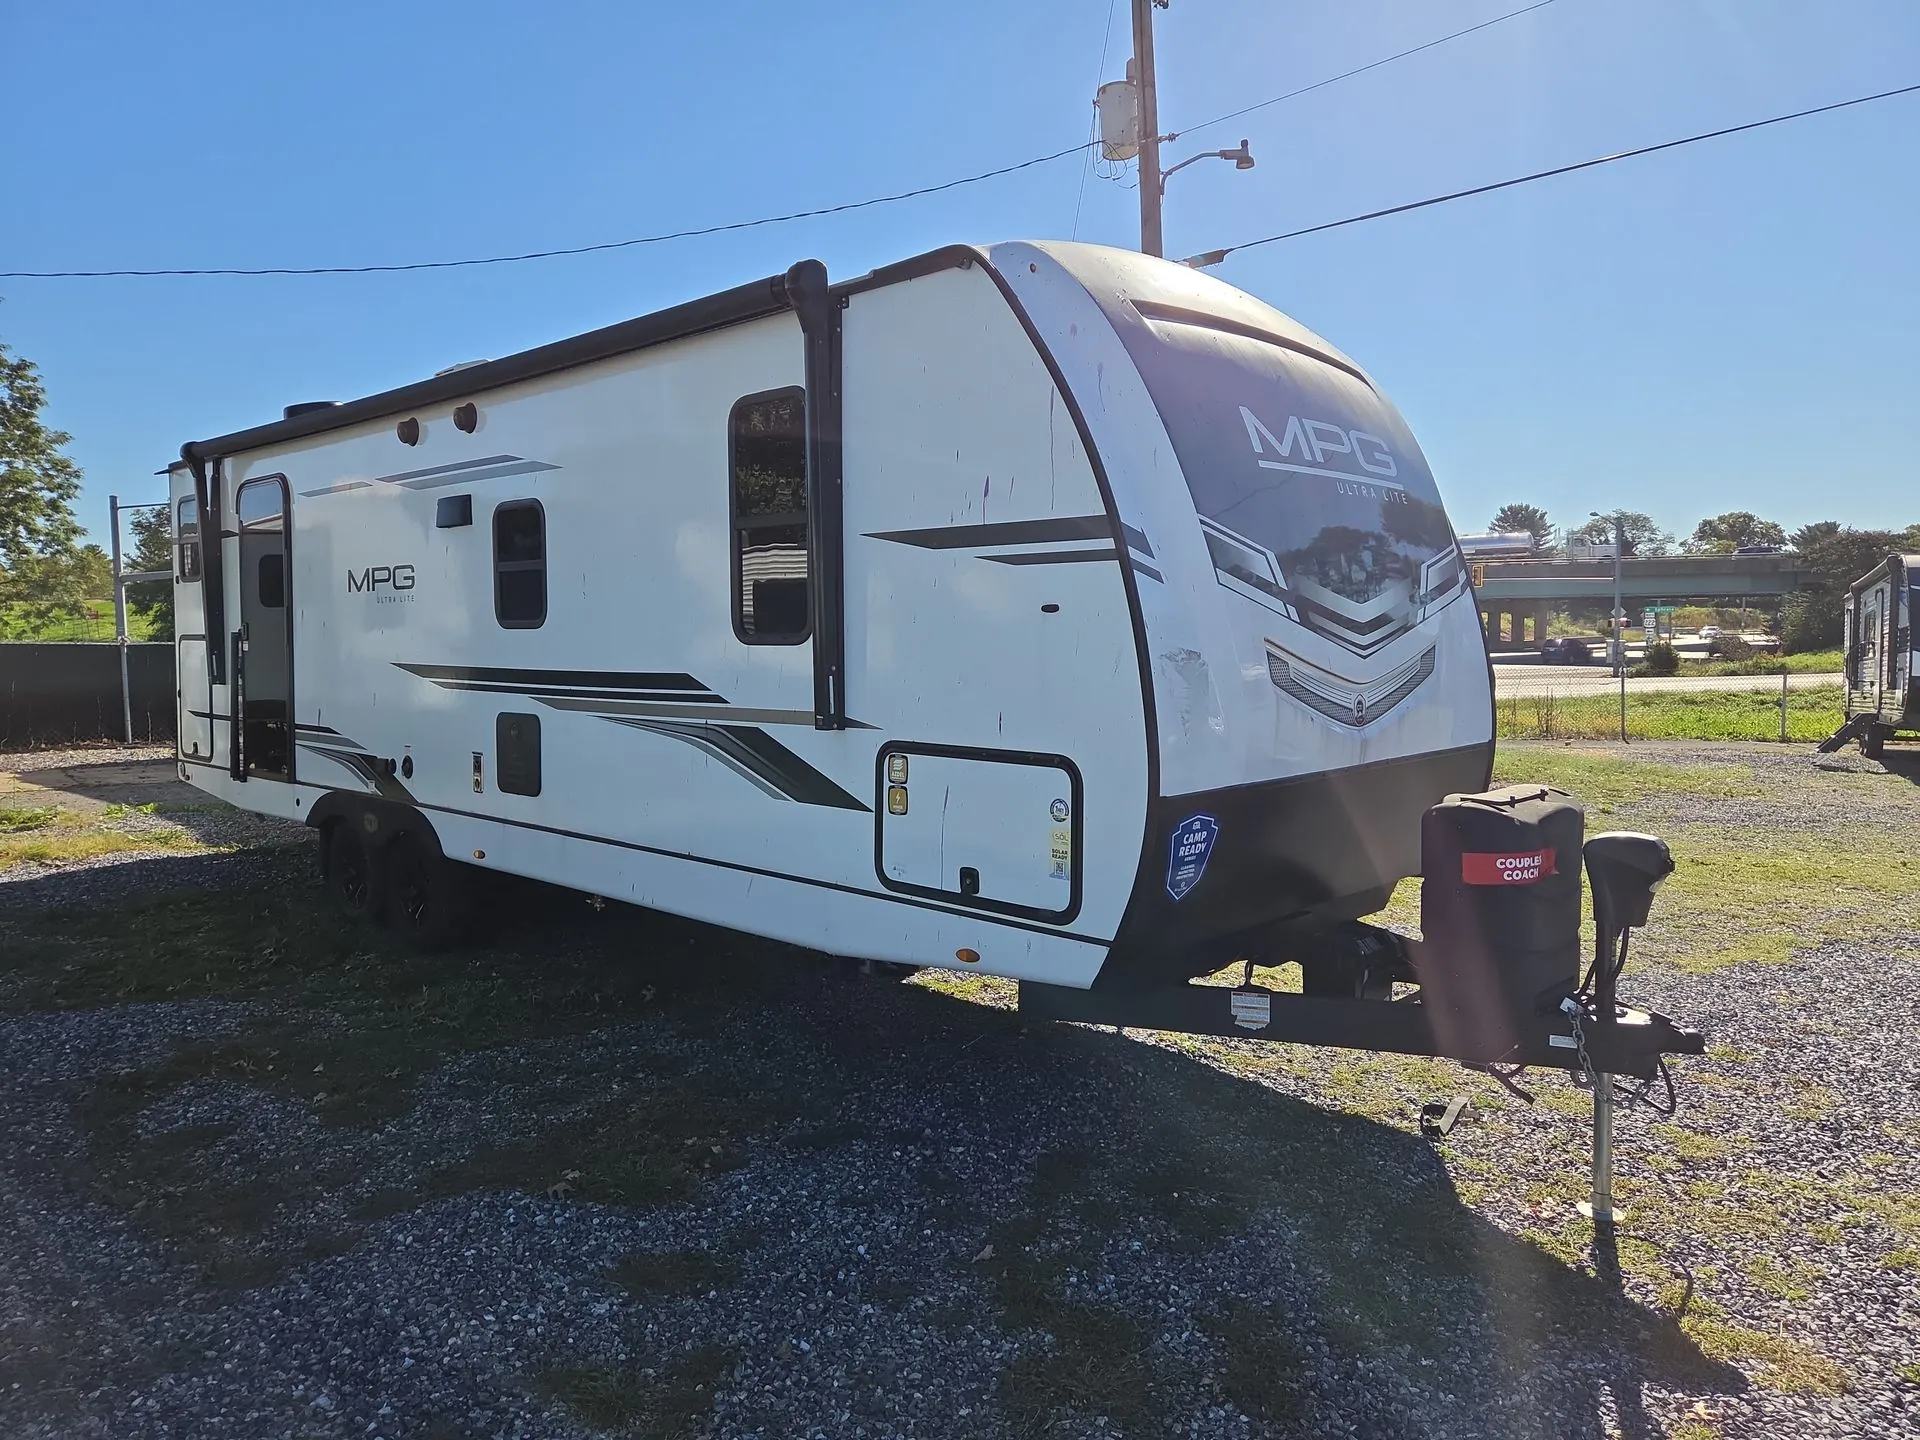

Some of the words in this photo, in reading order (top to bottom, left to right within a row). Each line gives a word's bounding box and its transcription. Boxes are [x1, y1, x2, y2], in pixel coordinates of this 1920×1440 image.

[1239, 405, 1398, 477] MPG
[1336, 481, 1377, 499] ULTRA
[1383, 490, 1408, 505] LITE
[347, 564, 416, 593] MPG
[1645, 619, 1656, 628] 222
[1183, 831, 1208, 845] CAMP
[1051, 848, 1068, 856] SOLAR
[1178, 842, 1208, 857] READY
[1051, 853, 1068, 861] READY
[1503, 868, 1539, 881] COACH
